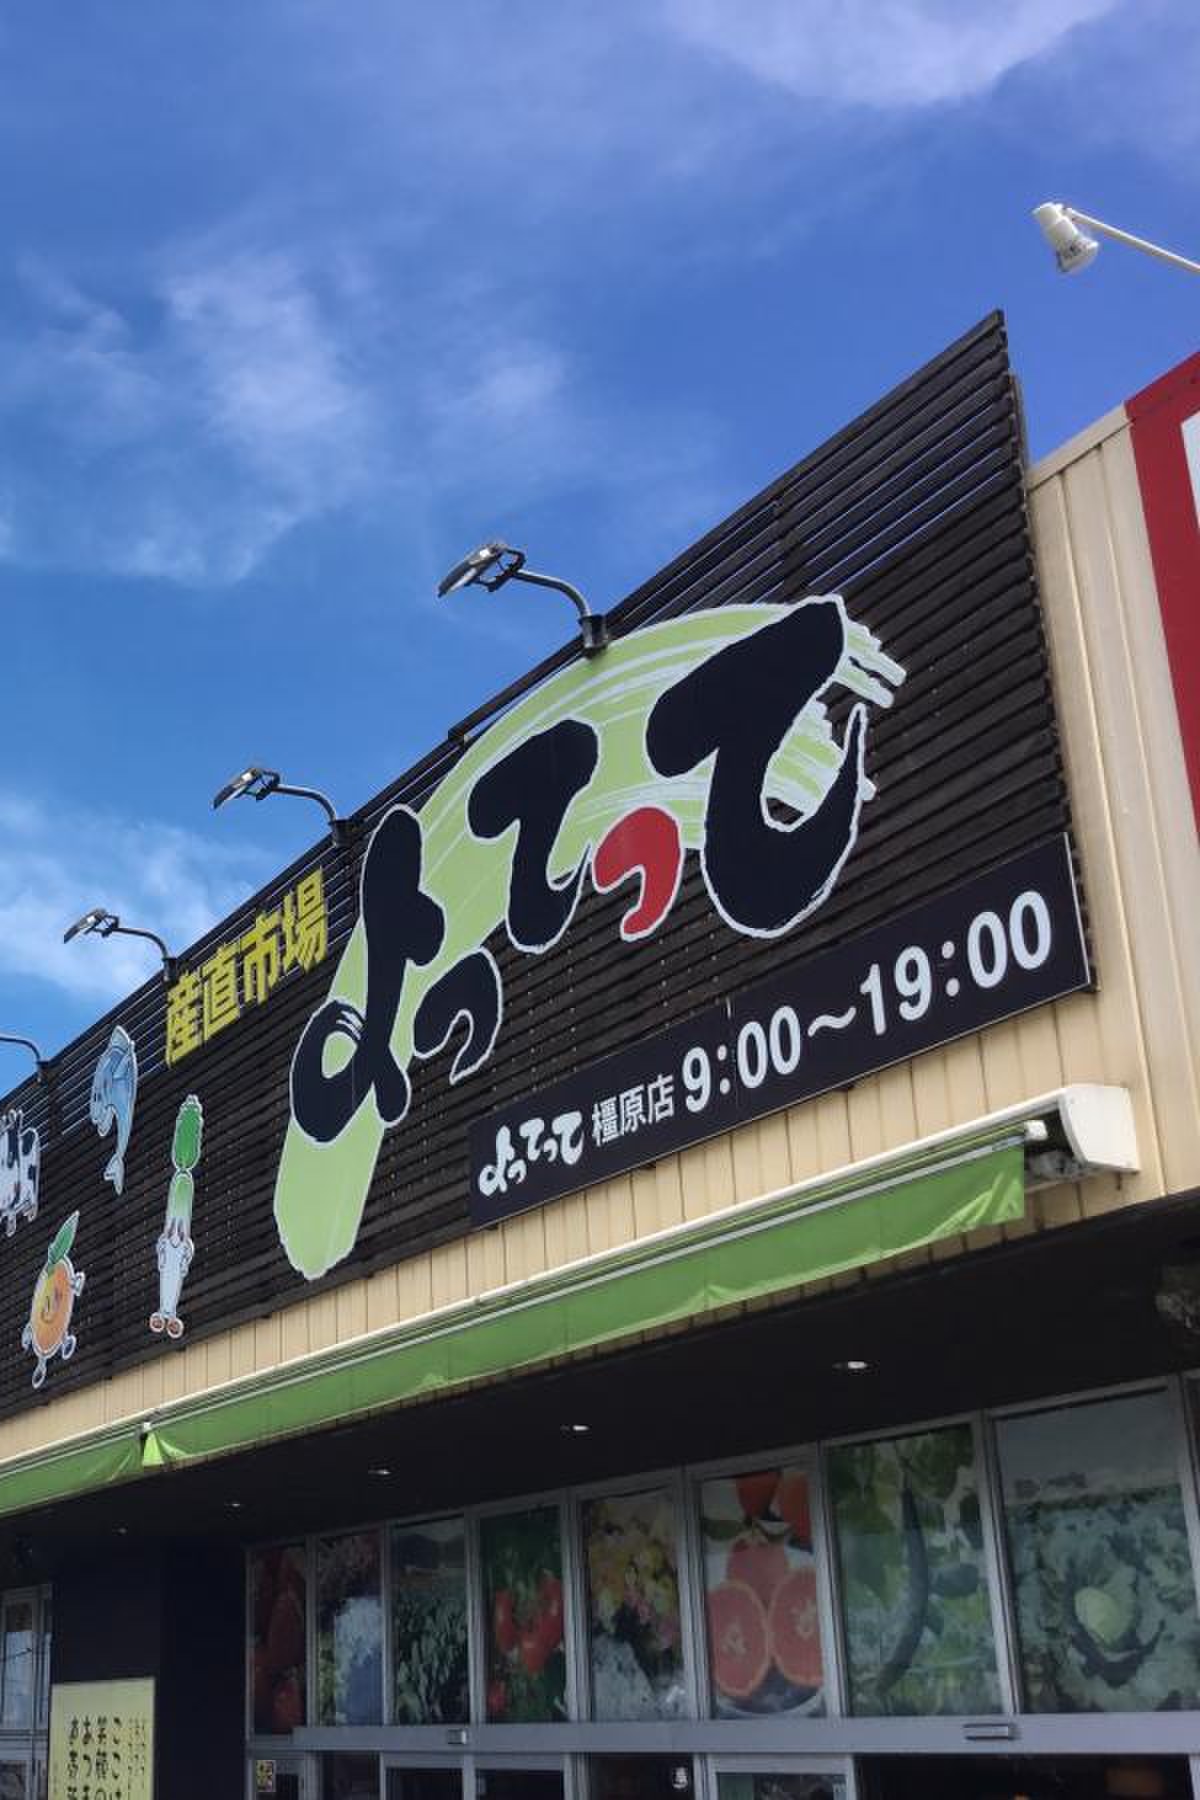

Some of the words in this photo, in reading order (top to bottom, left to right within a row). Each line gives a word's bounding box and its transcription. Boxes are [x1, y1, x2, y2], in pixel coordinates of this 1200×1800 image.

[166, 866, 329, 1068] 産直市場
[290, 594, 874, 1146] よってって
[479, 1111, 585, 1196] よってって
[591, 1073, 675, 1147] 橿原店
